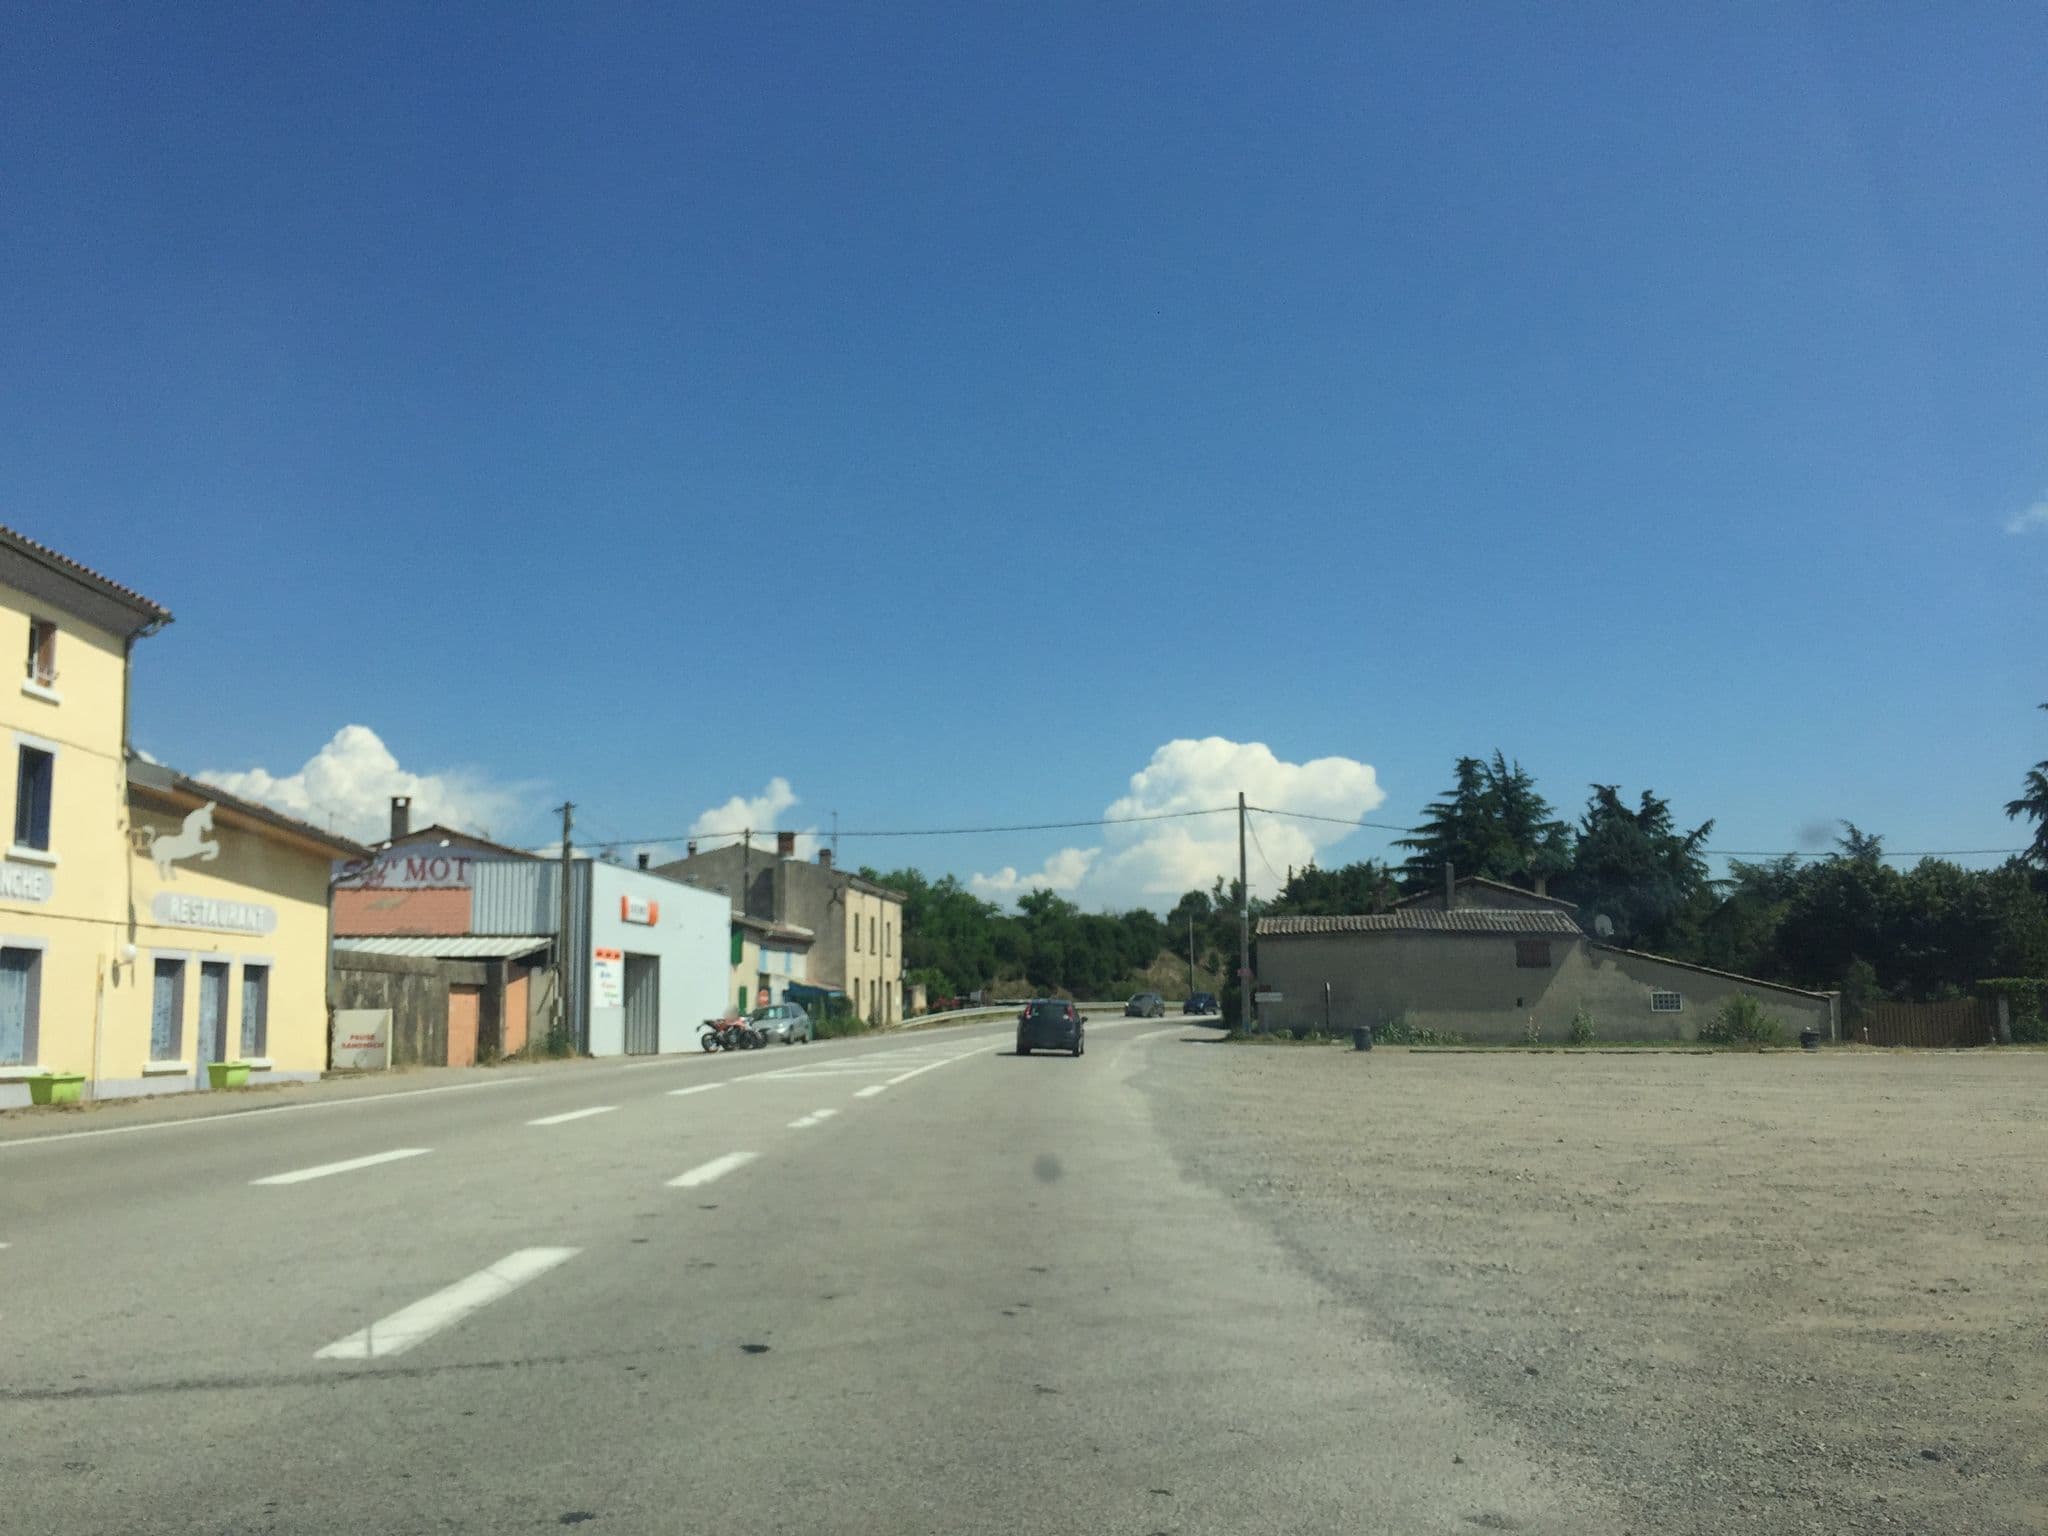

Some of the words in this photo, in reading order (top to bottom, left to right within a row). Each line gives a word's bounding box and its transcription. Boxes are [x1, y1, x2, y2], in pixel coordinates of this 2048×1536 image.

[403, 856, 472, 881] MOT
[0, 869, 41, 901] NCHE
[168, 895, 265, 931] RESTAURANT
